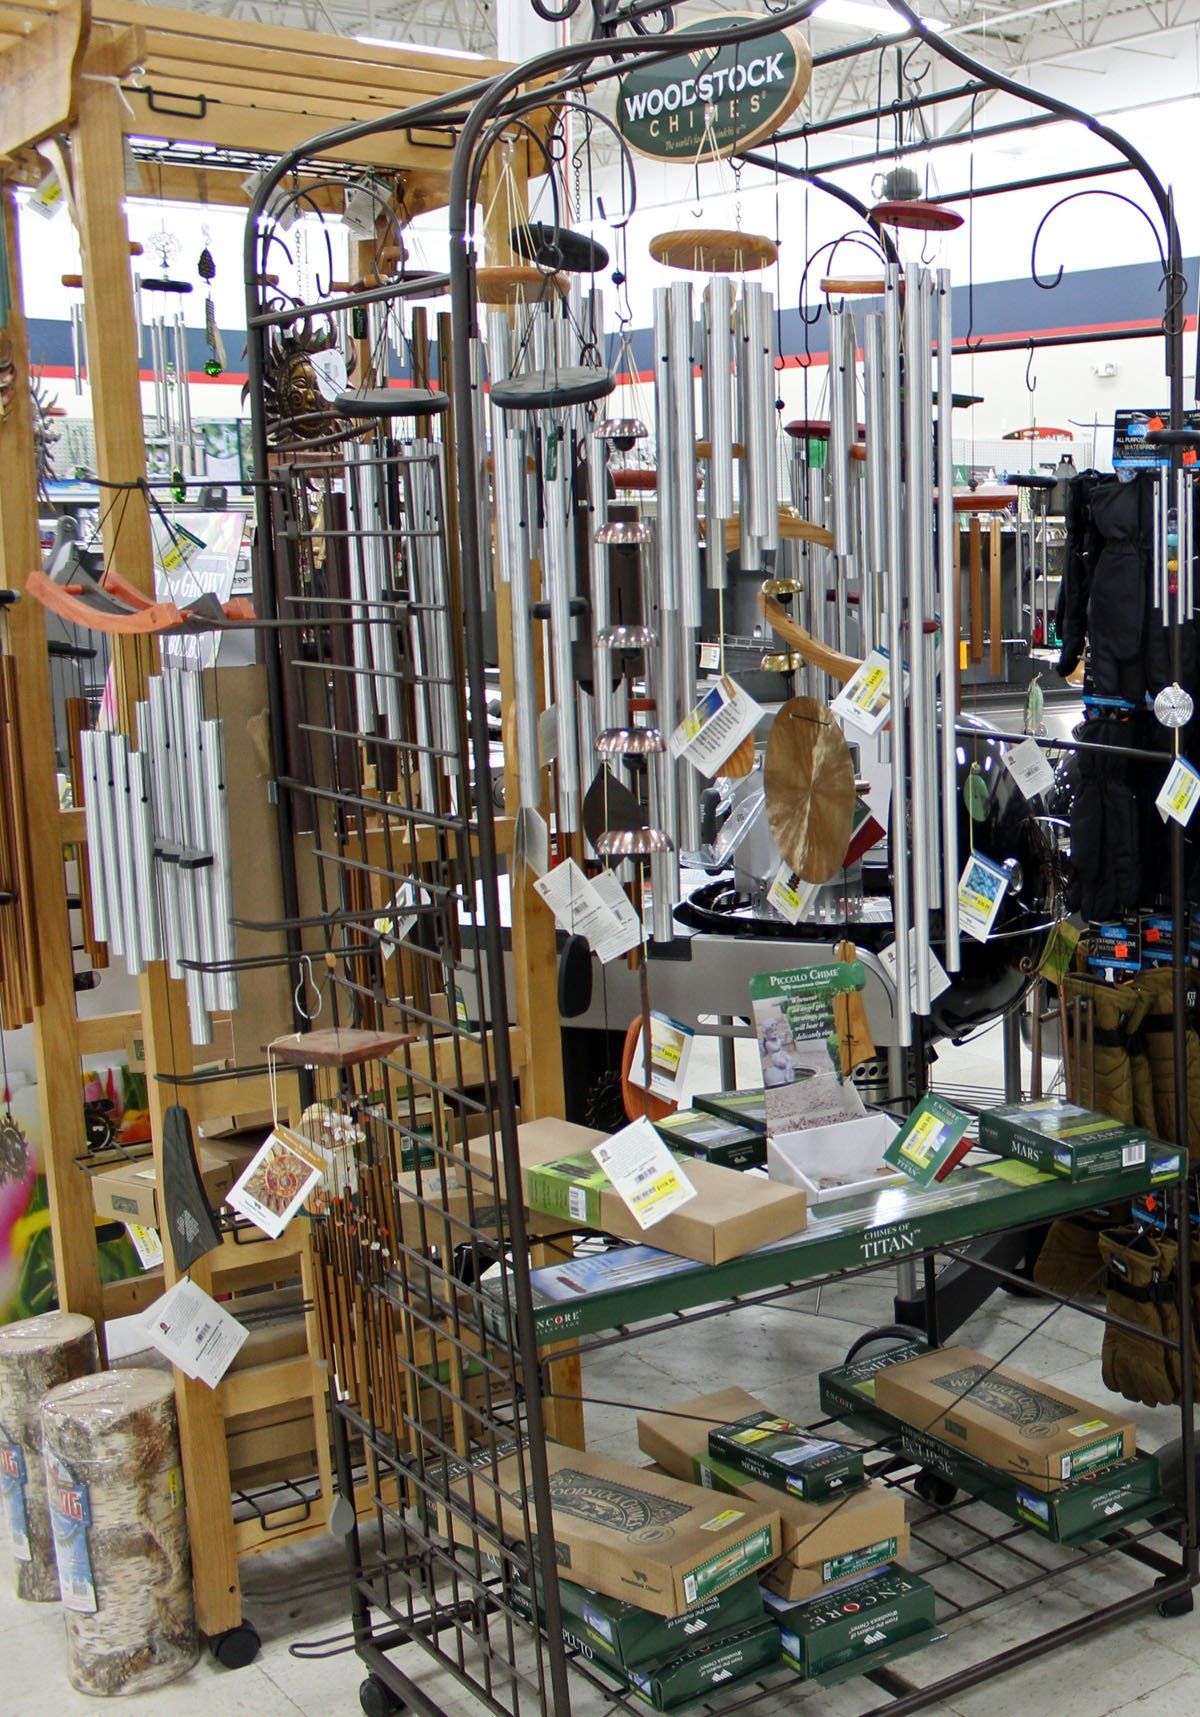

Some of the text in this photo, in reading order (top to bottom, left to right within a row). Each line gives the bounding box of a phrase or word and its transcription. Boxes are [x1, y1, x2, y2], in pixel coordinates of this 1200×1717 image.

[625, 52, 785, 122] WOODSTOCK
[769, 967, 839, 986] PICCOLO CHIME
[864, 1223, 910, 1241] CHIMES OF
[550, 1487, 624, 1504] OODSTOCK
[885, 1615, 899, 1625] From
[857, 1626, 875, 1635] makers
[562, 1628, 594, 1660] PLUTO
